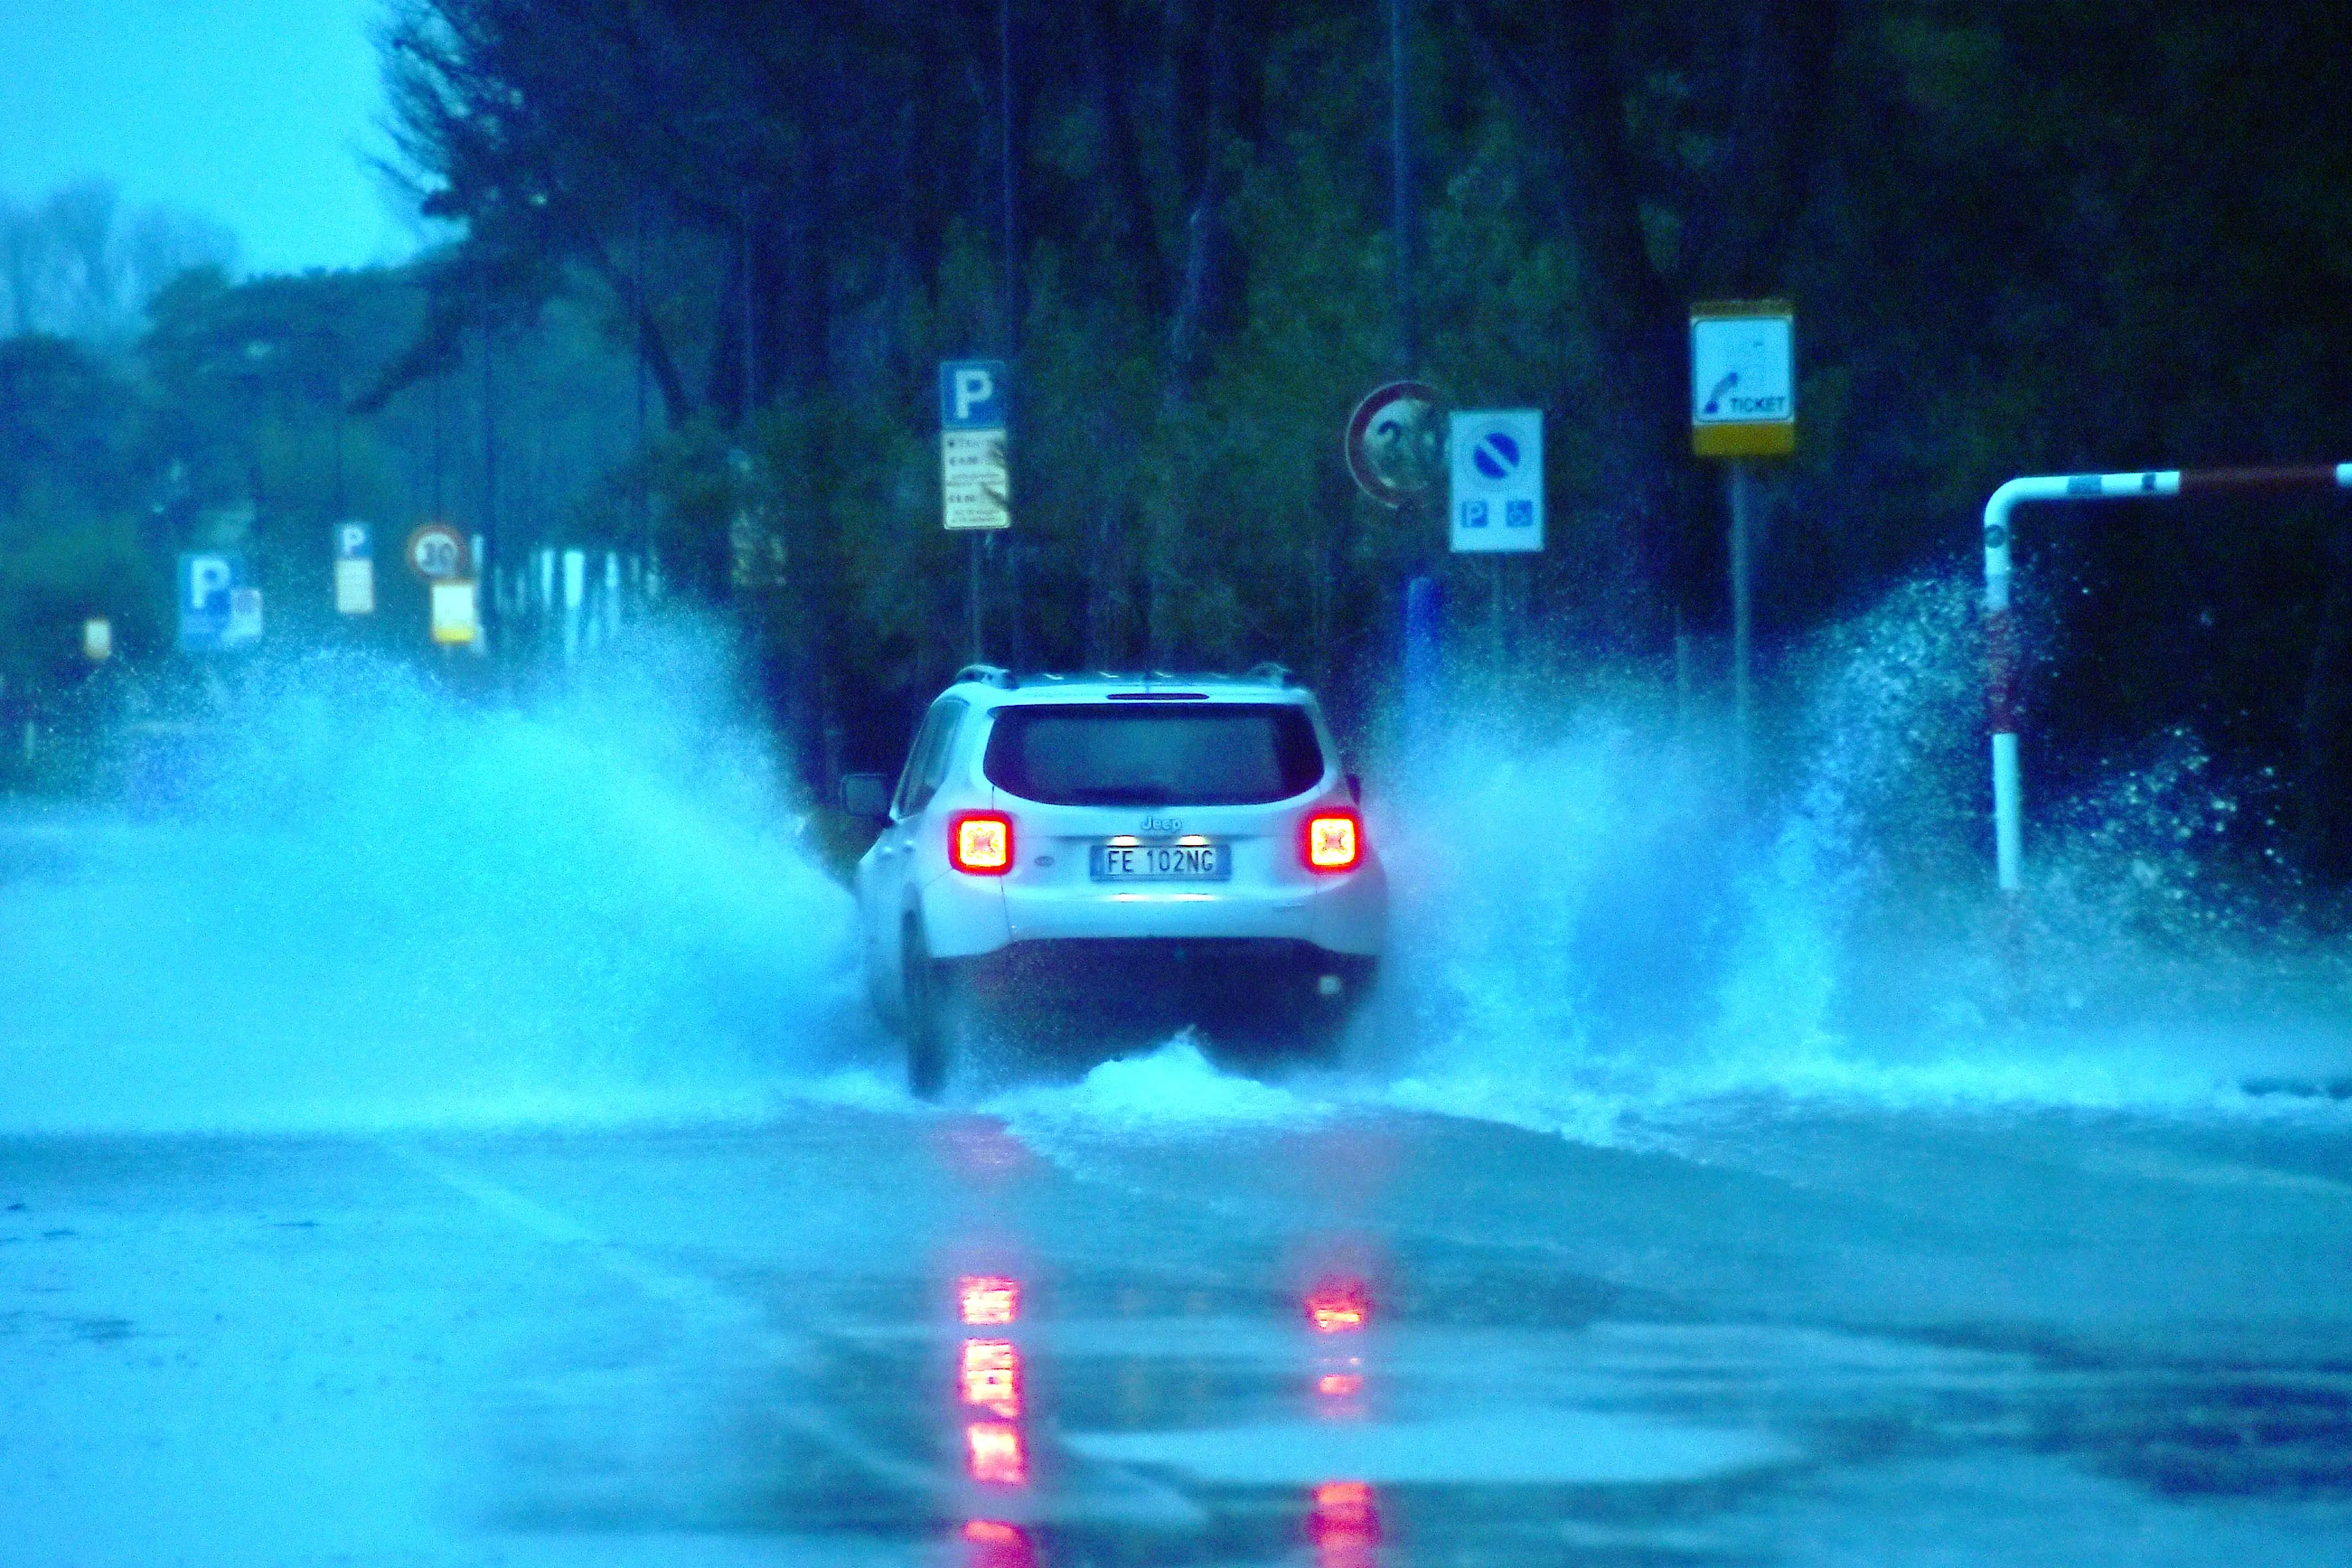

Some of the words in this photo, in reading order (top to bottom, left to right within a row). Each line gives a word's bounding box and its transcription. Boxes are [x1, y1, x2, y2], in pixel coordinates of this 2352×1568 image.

[955, 369, 993, 419] P
[1730, 397, 1786, 412] TICKET
[1465, 501, 1484, 526] P
[341, 525, 364, 556] P
[191, 558, 230, 609] P
[1141, 815, 1182, 832] Jeep
[1108, 850, 1134, 872] FE
[1146, 850, 1214, 872] 102NG
